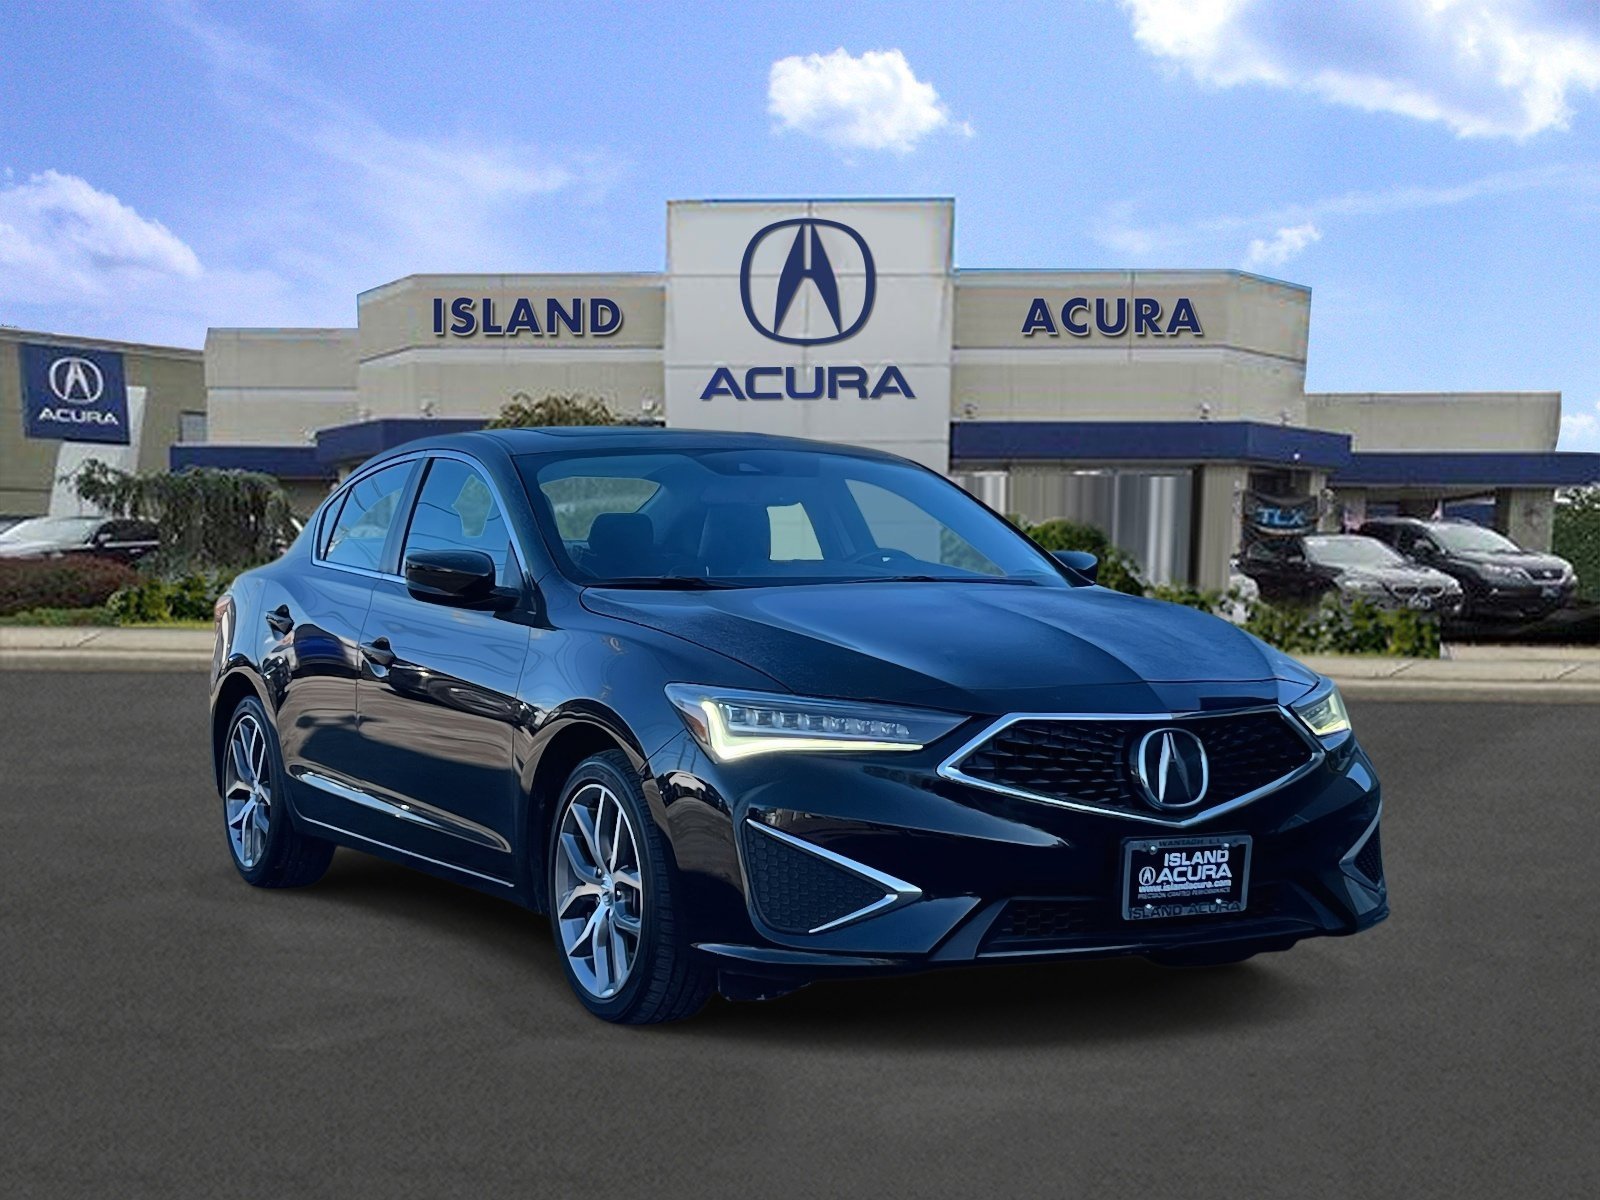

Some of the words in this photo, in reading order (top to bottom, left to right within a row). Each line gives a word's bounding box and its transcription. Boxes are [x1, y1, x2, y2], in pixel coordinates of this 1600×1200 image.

[433, 297, 624, 337] ISLAND
[1021, 297, 1204, 336] ACURA
[700, 366, 916, 401] ACURA
[38, 407, 119, 425] ACURA
[1257, 507, 1306, 524] TLX
[1164, 850, 1229, 867] ISLAND
[1156, 863, 1232, 883] ACURA
[1129, 904, 1183, 919] ISLAND
[1188, 900, 1241, 914] ACURA
